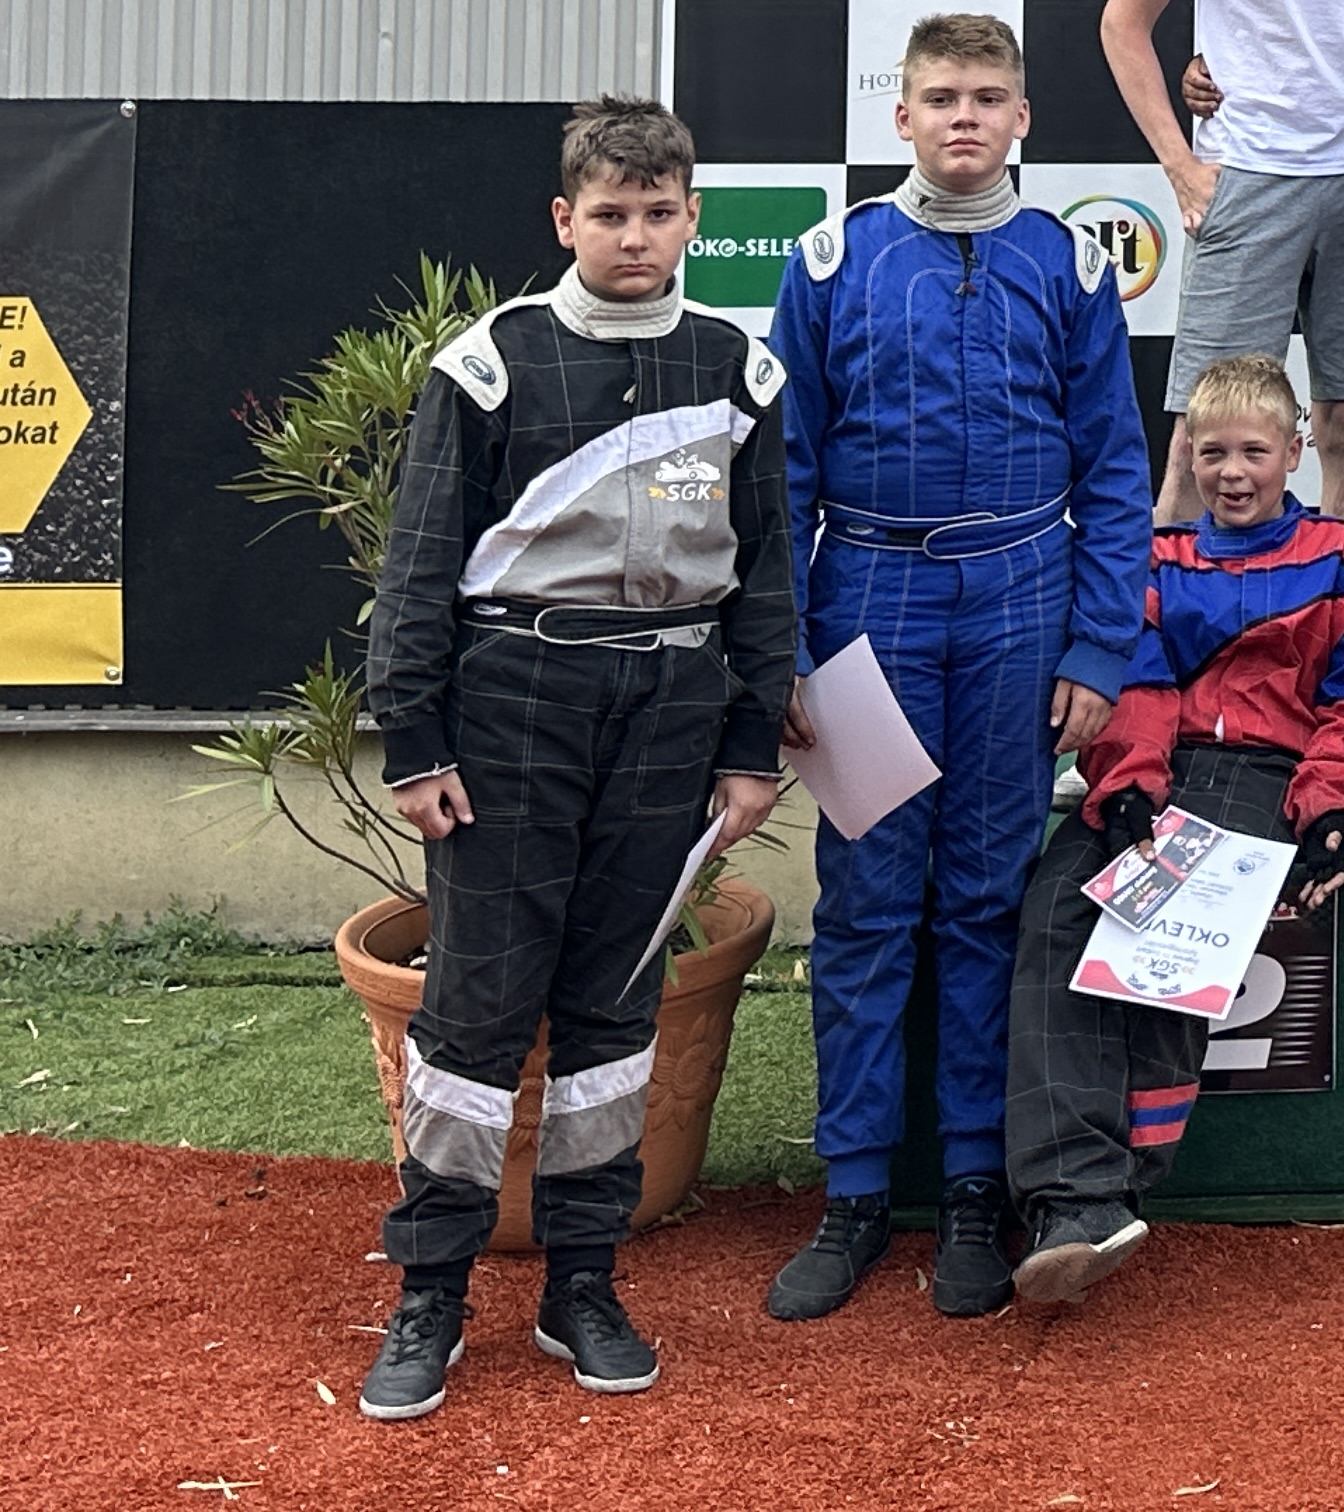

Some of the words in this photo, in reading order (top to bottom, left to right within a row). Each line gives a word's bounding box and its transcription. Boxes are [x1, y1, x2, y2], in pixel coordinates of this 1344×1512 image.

[859, 73, 902, 90] HOT
[687, 234, 800, 258] ÖKO-SELE
[667, 483, 712, 502] SGK
[1145, 918, 1231, 948] OKLEV
